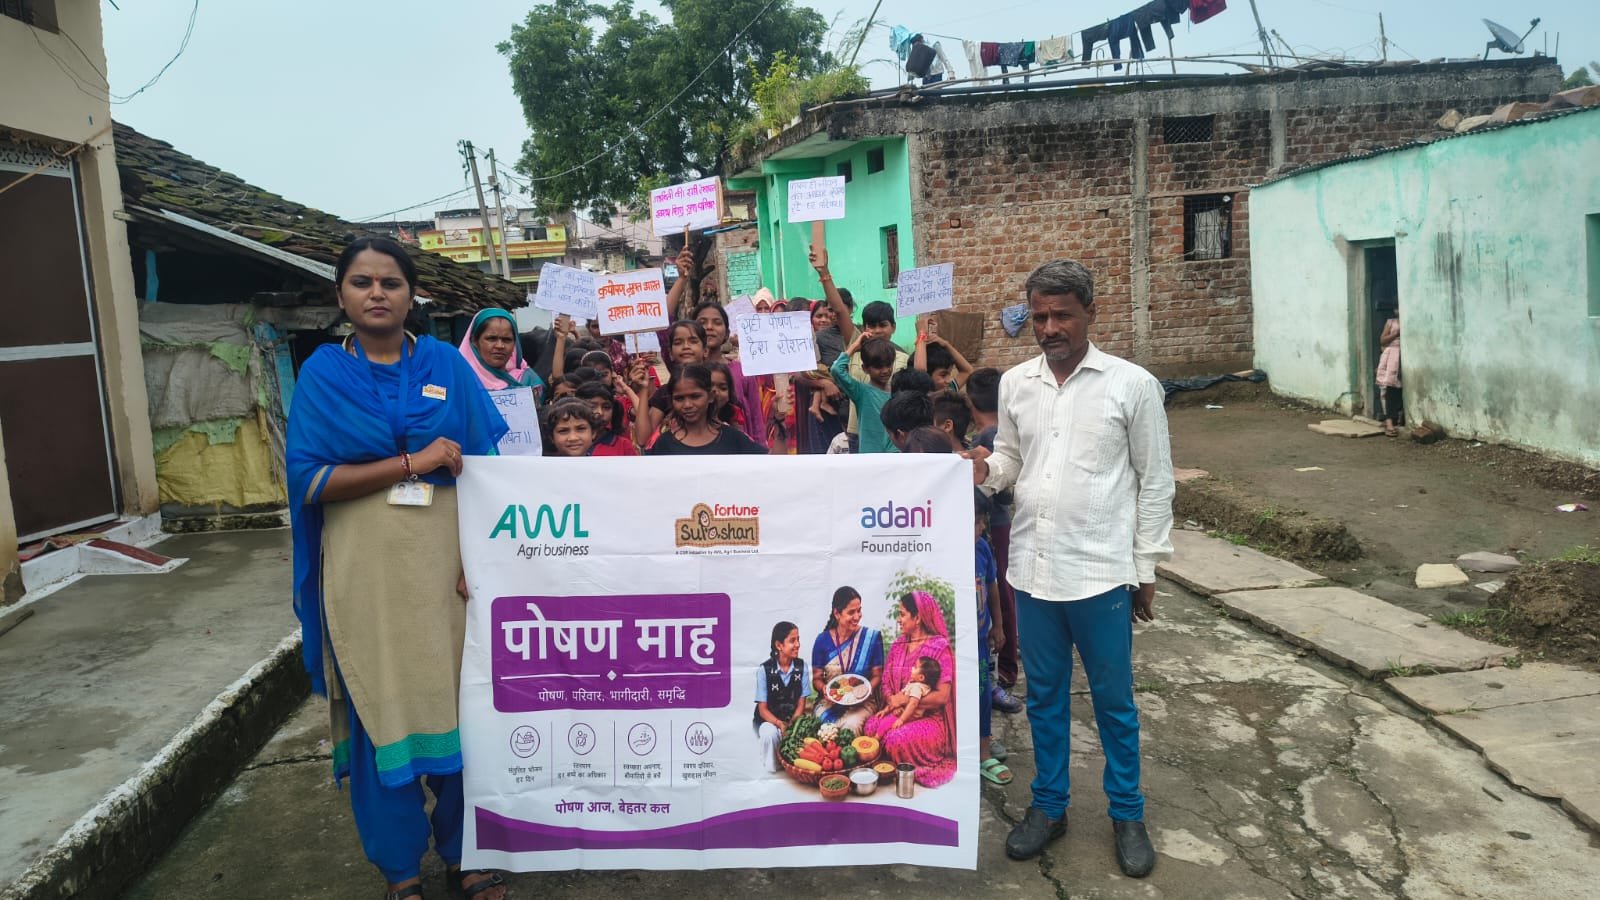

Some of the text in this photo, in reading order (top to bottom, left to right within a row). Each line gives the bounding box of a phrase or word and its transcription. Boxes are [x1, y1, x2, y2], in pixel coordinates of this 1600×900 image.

[636, 302, 662, 317] भारत
[714, 503, 759, 516] fortune
[860, 499, 932, 529] adani
[489, 503, 589, 539] AWL
[517, 543, 590, 559] Agri business
[861, 540, 932, 553] Foundation
[501, 602, 719, 665] पोषण माह
[572, 687, 605, 702] परिवार,
[658, 685, 687, 704] समृद्धि
[555, 798, 671, 815] पोषण आज, बेहतर कल
